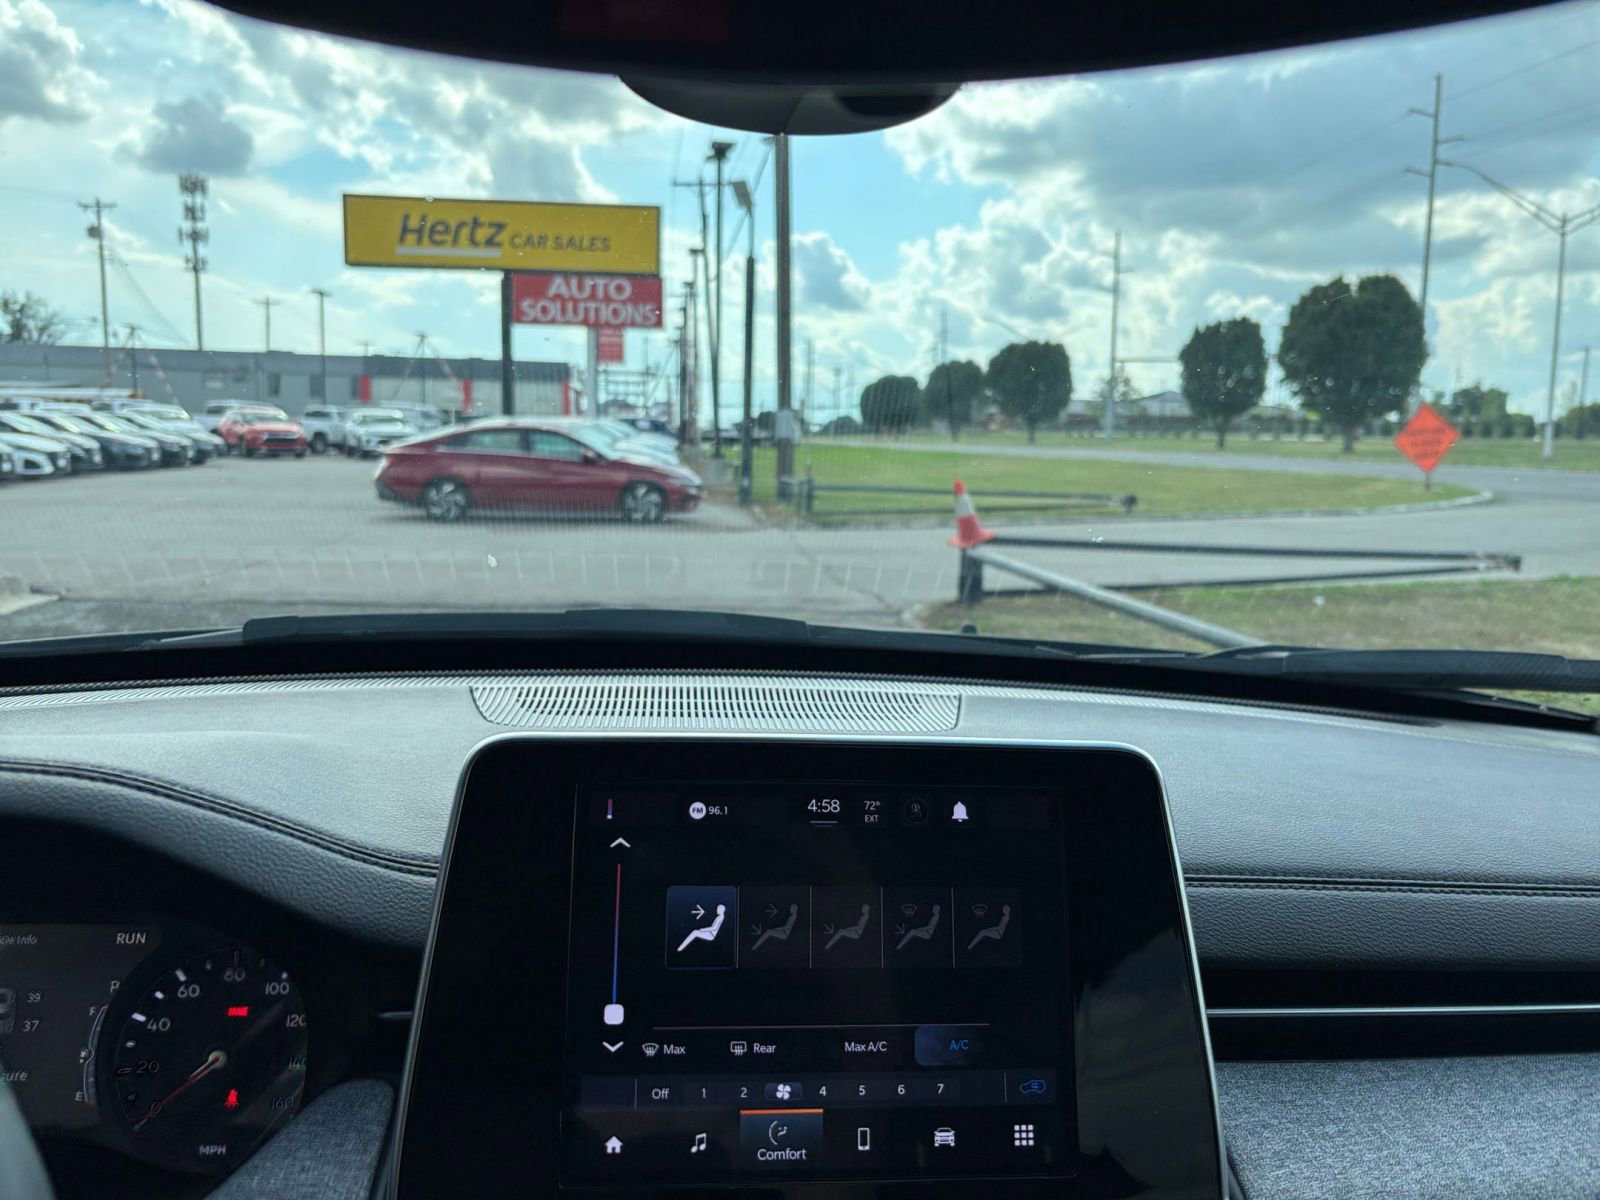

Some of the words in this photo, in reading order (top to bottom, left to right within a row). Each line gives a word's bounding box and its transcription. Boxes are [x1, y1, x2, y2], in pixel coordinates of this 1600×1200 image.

[399, 213, 508, 248] Hertz
[509, 233, 549, 250] CAR
[554, 235, 611, 251] SALES
[547, 274, 633, 301] AUTO
[520, 298, 656, 326] SOLUTIONS
[708, 805, 728, 815] 96.1
[807, 798, 841, 814] 4:58
[864, 801, 880, 811] 72°
[864, 814, 879, 823] EXT
[116, 933, 146, 945] RUN
[178, 984, 200, 998] 60
[265, 982, 289, 994] 100
[27, 992, 41, 1003] 39
[23, 1021, 39, 1031] 37
[147, 1018, 171, 1031] 40
[663, 1043, 686, 1054] Max
[753, 1042, 776, 1054] Rear
[844, 1041, 866, 1053] Max
[866, 1040, 888, 1053] A/C
[949, 1039, 969, 1051] A/C
[137, 1061, 159, 1073] 20
[652, 1087, 670, 1099] Off
[740, 1087, 748, 1098] 2
[819, 1085, 827, 1096] 4
[859, 1085, 866, 1096] 5
[898, 1084, 905, 1095] 6
[937, 1083, 944, 1094] 7
[200, 1145, 226, 1156] MPH
[757, 1147, 807, 1161] Comfort
